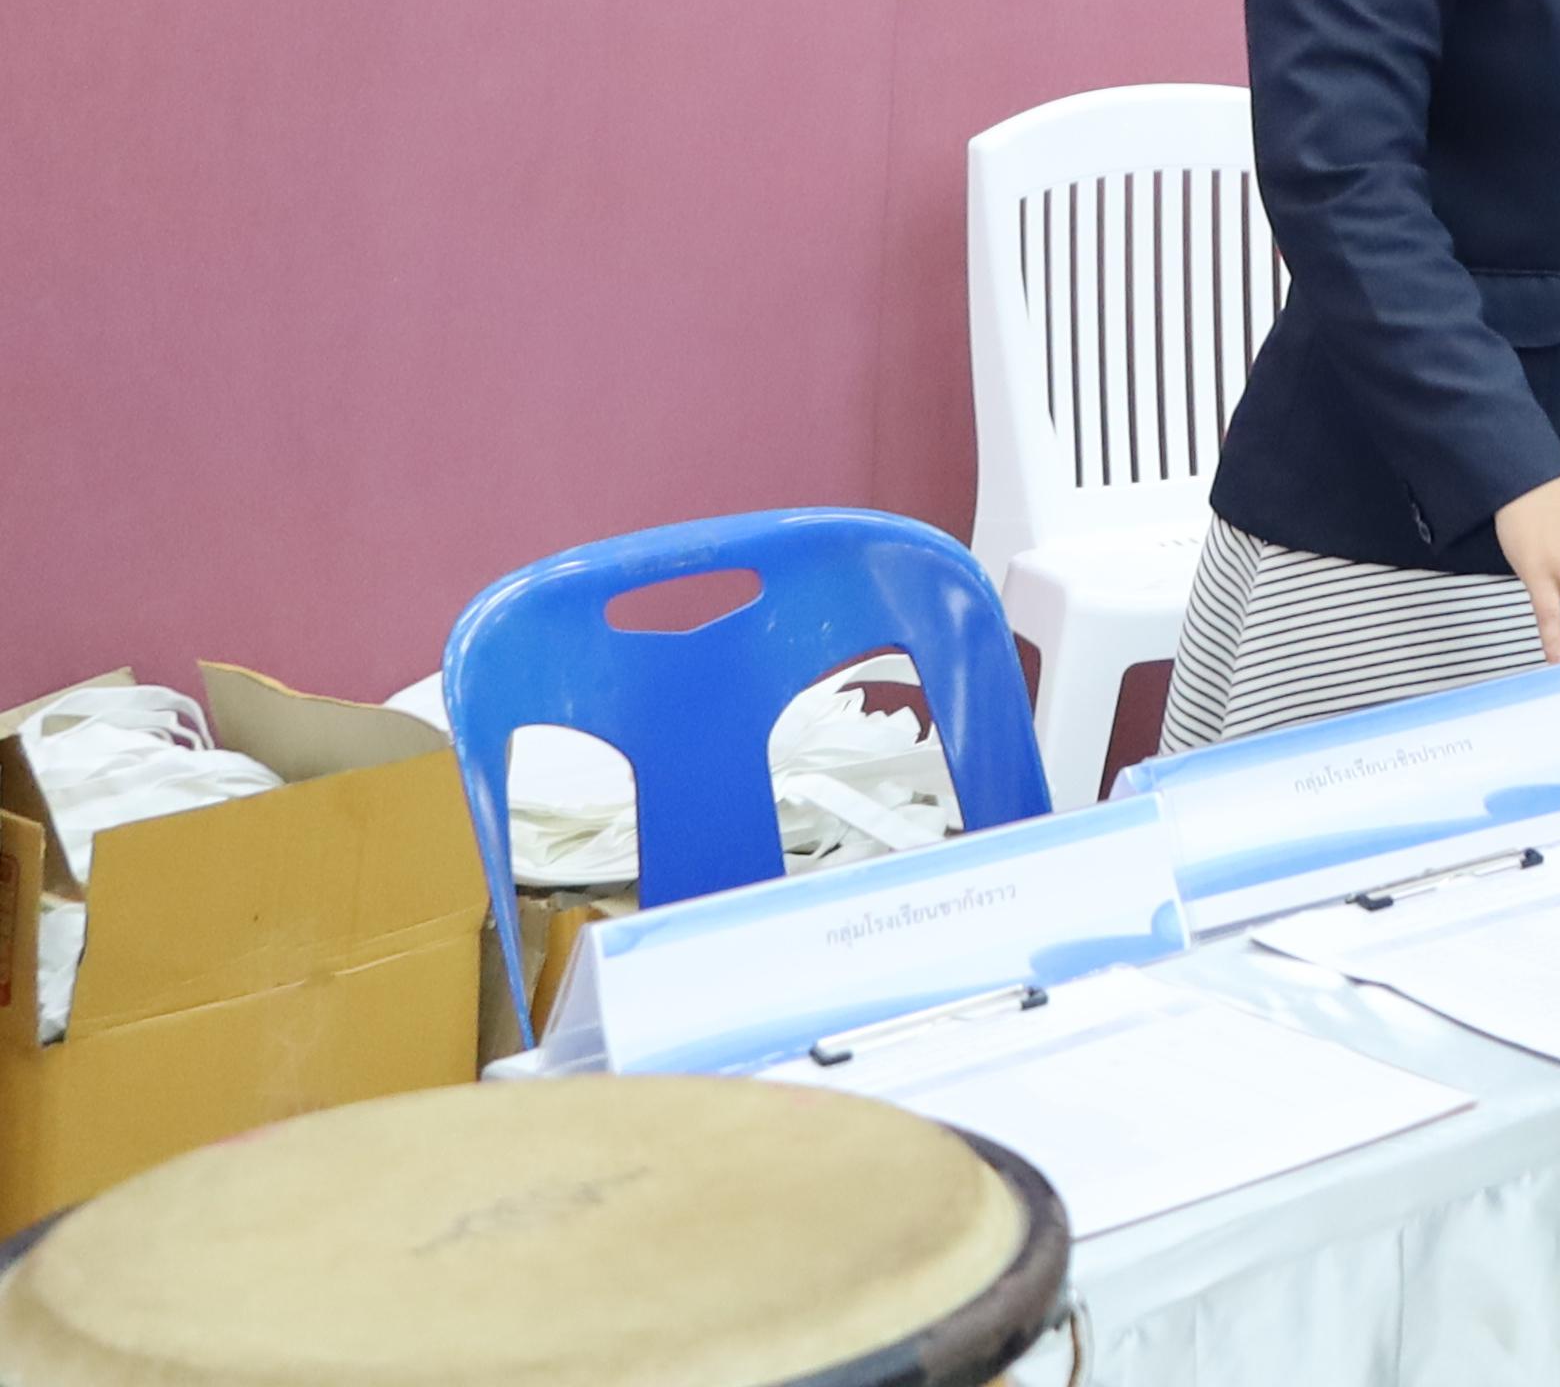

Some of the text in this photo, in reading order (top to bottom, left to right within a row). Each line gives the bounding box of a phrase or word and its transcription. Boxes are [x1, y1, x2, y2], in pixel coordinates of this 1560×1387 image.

[1294, 737, 1474, 795] กลุ่มโรงเรียนวชิรปราการ
